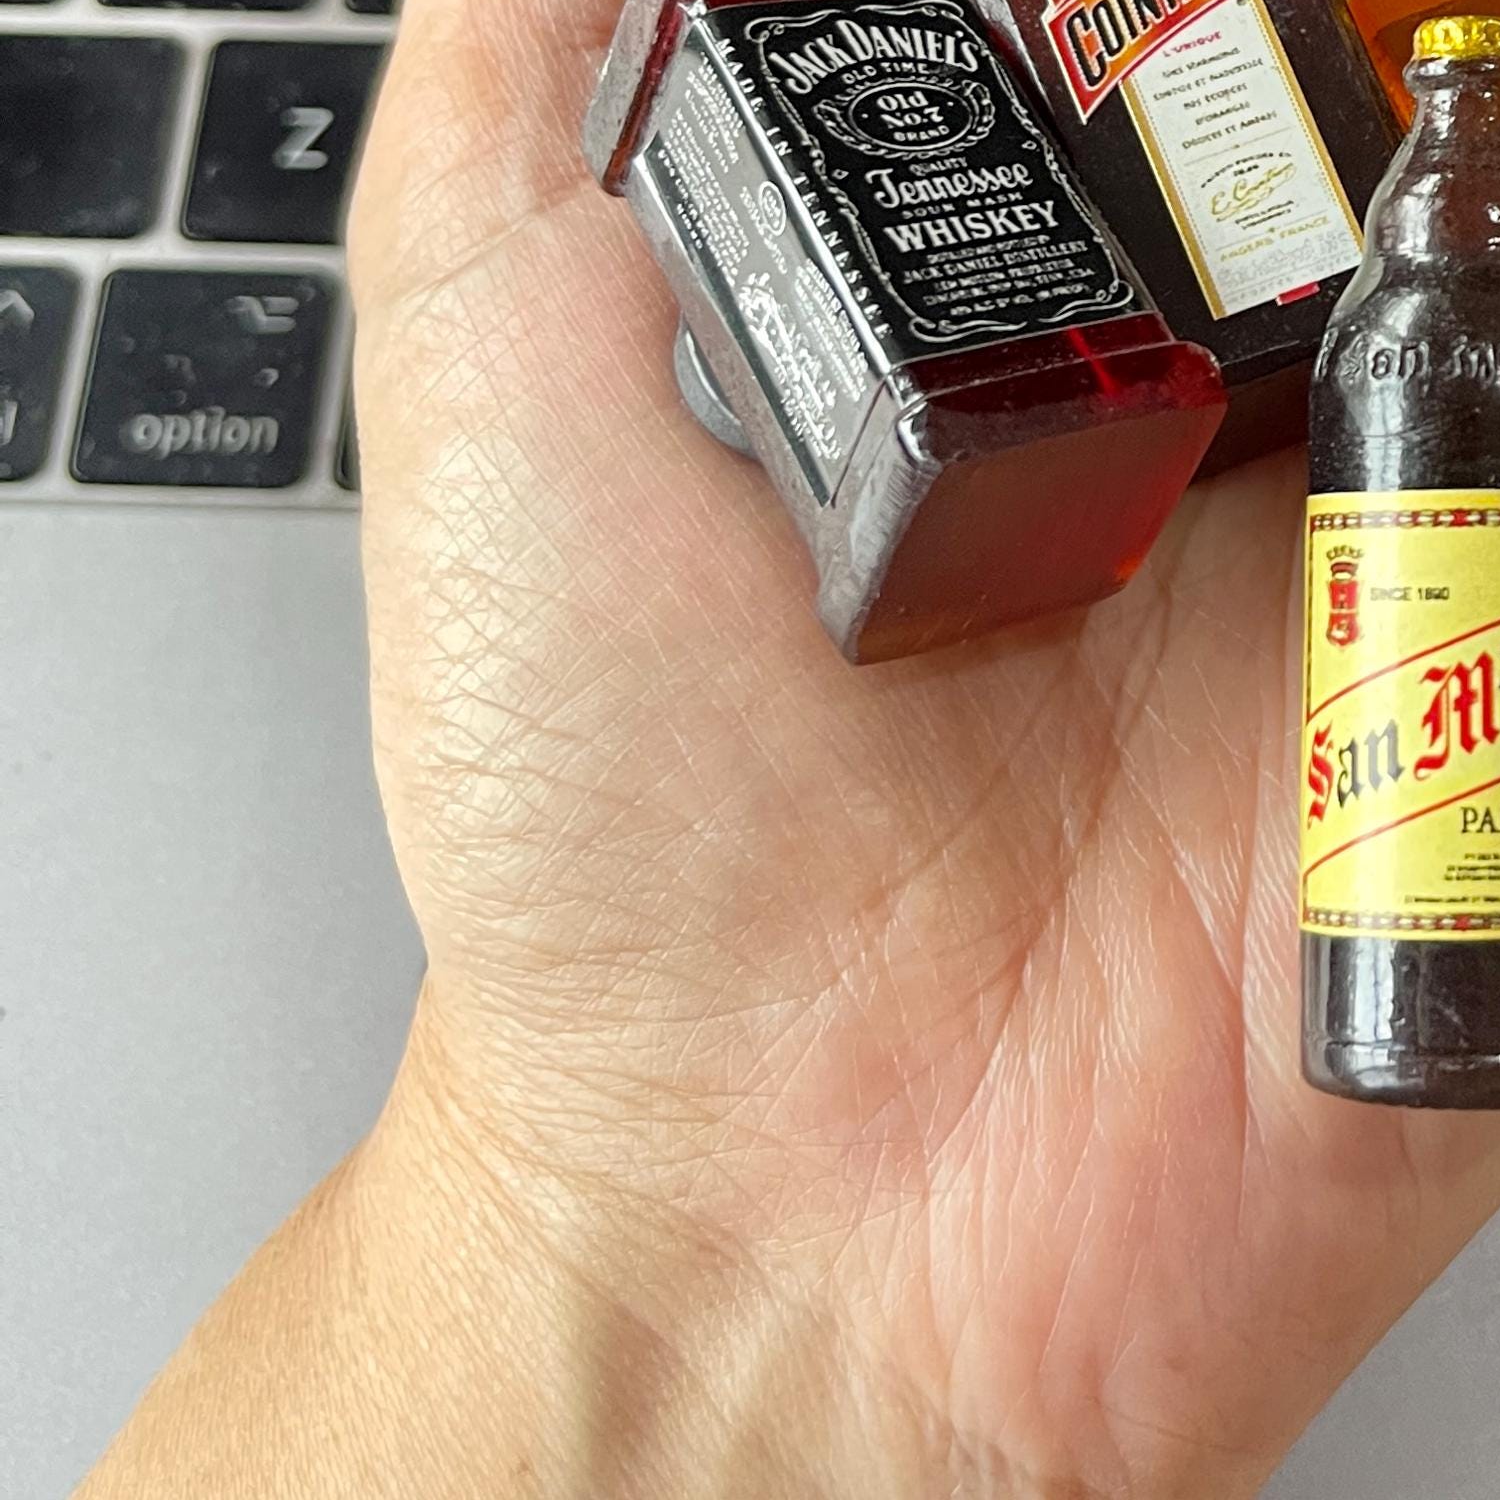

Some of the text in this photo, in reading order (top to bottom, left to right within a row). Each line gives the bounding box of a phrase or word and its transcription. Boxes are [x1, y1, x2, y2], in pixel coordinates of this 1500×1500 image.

[768, 19, 982, 95] JACK DANIEL'S
[842, 61, 930, 85] OLD TIME
[876, 90, 929, 112] Old
[274, 107, 333, 170] Z
[892, 124, 951, 142] BRAND
[715, 37, 766, 113] MADE
[765, 126, 793, 158] IN
[793, 170, 895, 340] TENNESSEE
[864, 162, 1034, 209] Tennessee
[909, 156, 969, 177] QUALITY
[966, 191, 1024, 208] MASH
[883, 199, 1059, 254] WHISKEY
[125, 406, 280, 460] option
[1370, 586, 1413, 602] SINCE
[1306, 718, 1406, 831] San
